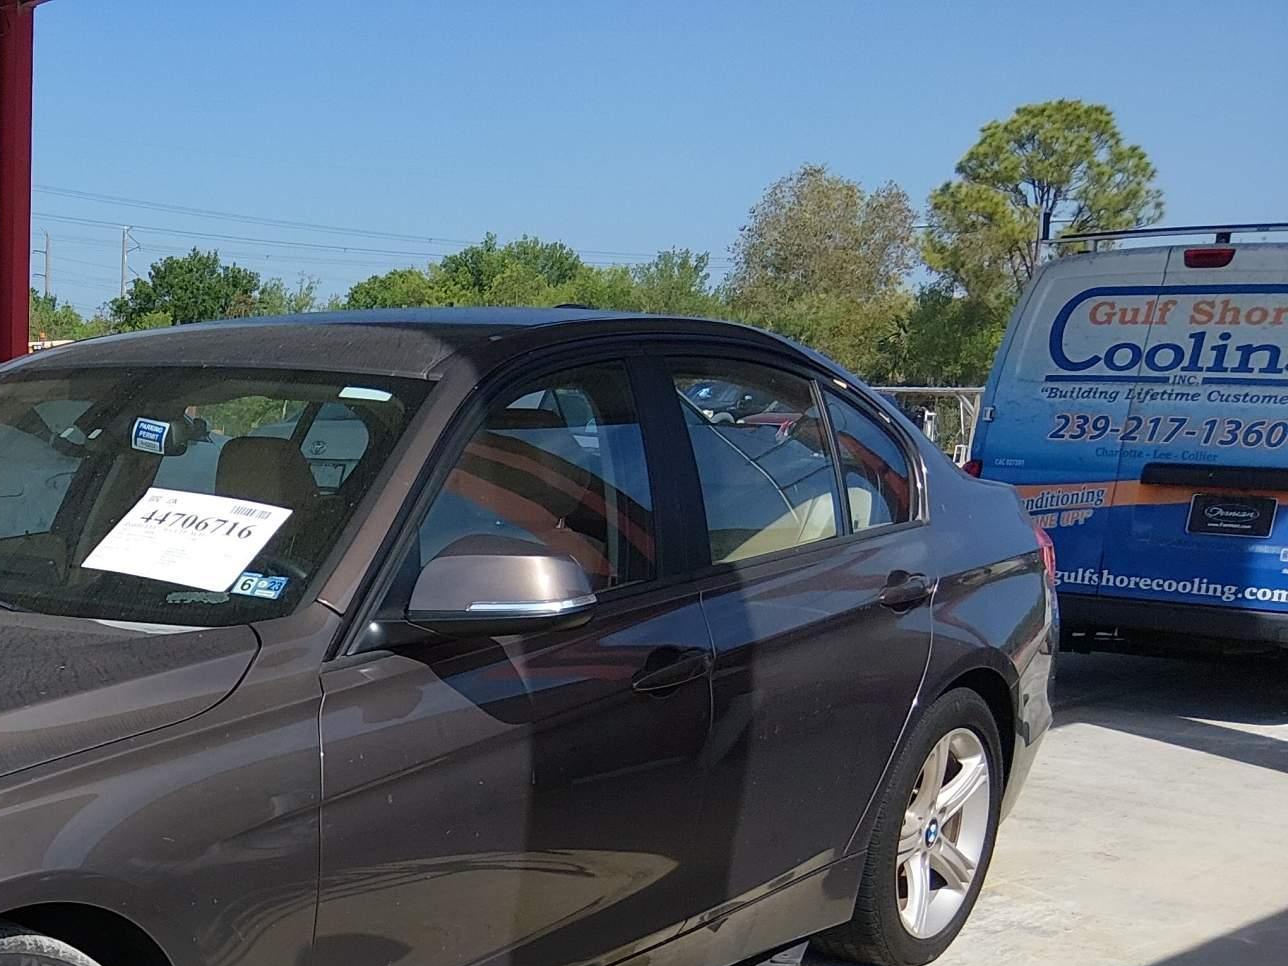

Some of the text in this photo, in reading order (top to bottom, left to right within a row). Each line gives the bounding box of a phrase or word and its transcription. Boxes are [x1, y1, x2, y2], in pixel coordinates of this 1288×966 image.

[1089, 299, 1177, 326] Gulf
[1049, 302, 1288, 374] Coolin
[1170, 375, 1200, 386] INC.
[1125, 388, 1201, 403] Lifetime
[138, 422, 164, 434] PARKING
[138, 430, 160, 441] PERMIT
[1047, 413, 1288, 448] 239-217-1360
[1023, 485, 1105, 510] nditioning
[140, 509, 258, 539] 44706716
[240, 578, 254, 592] 6
[267, 580, 283, 592] 23
